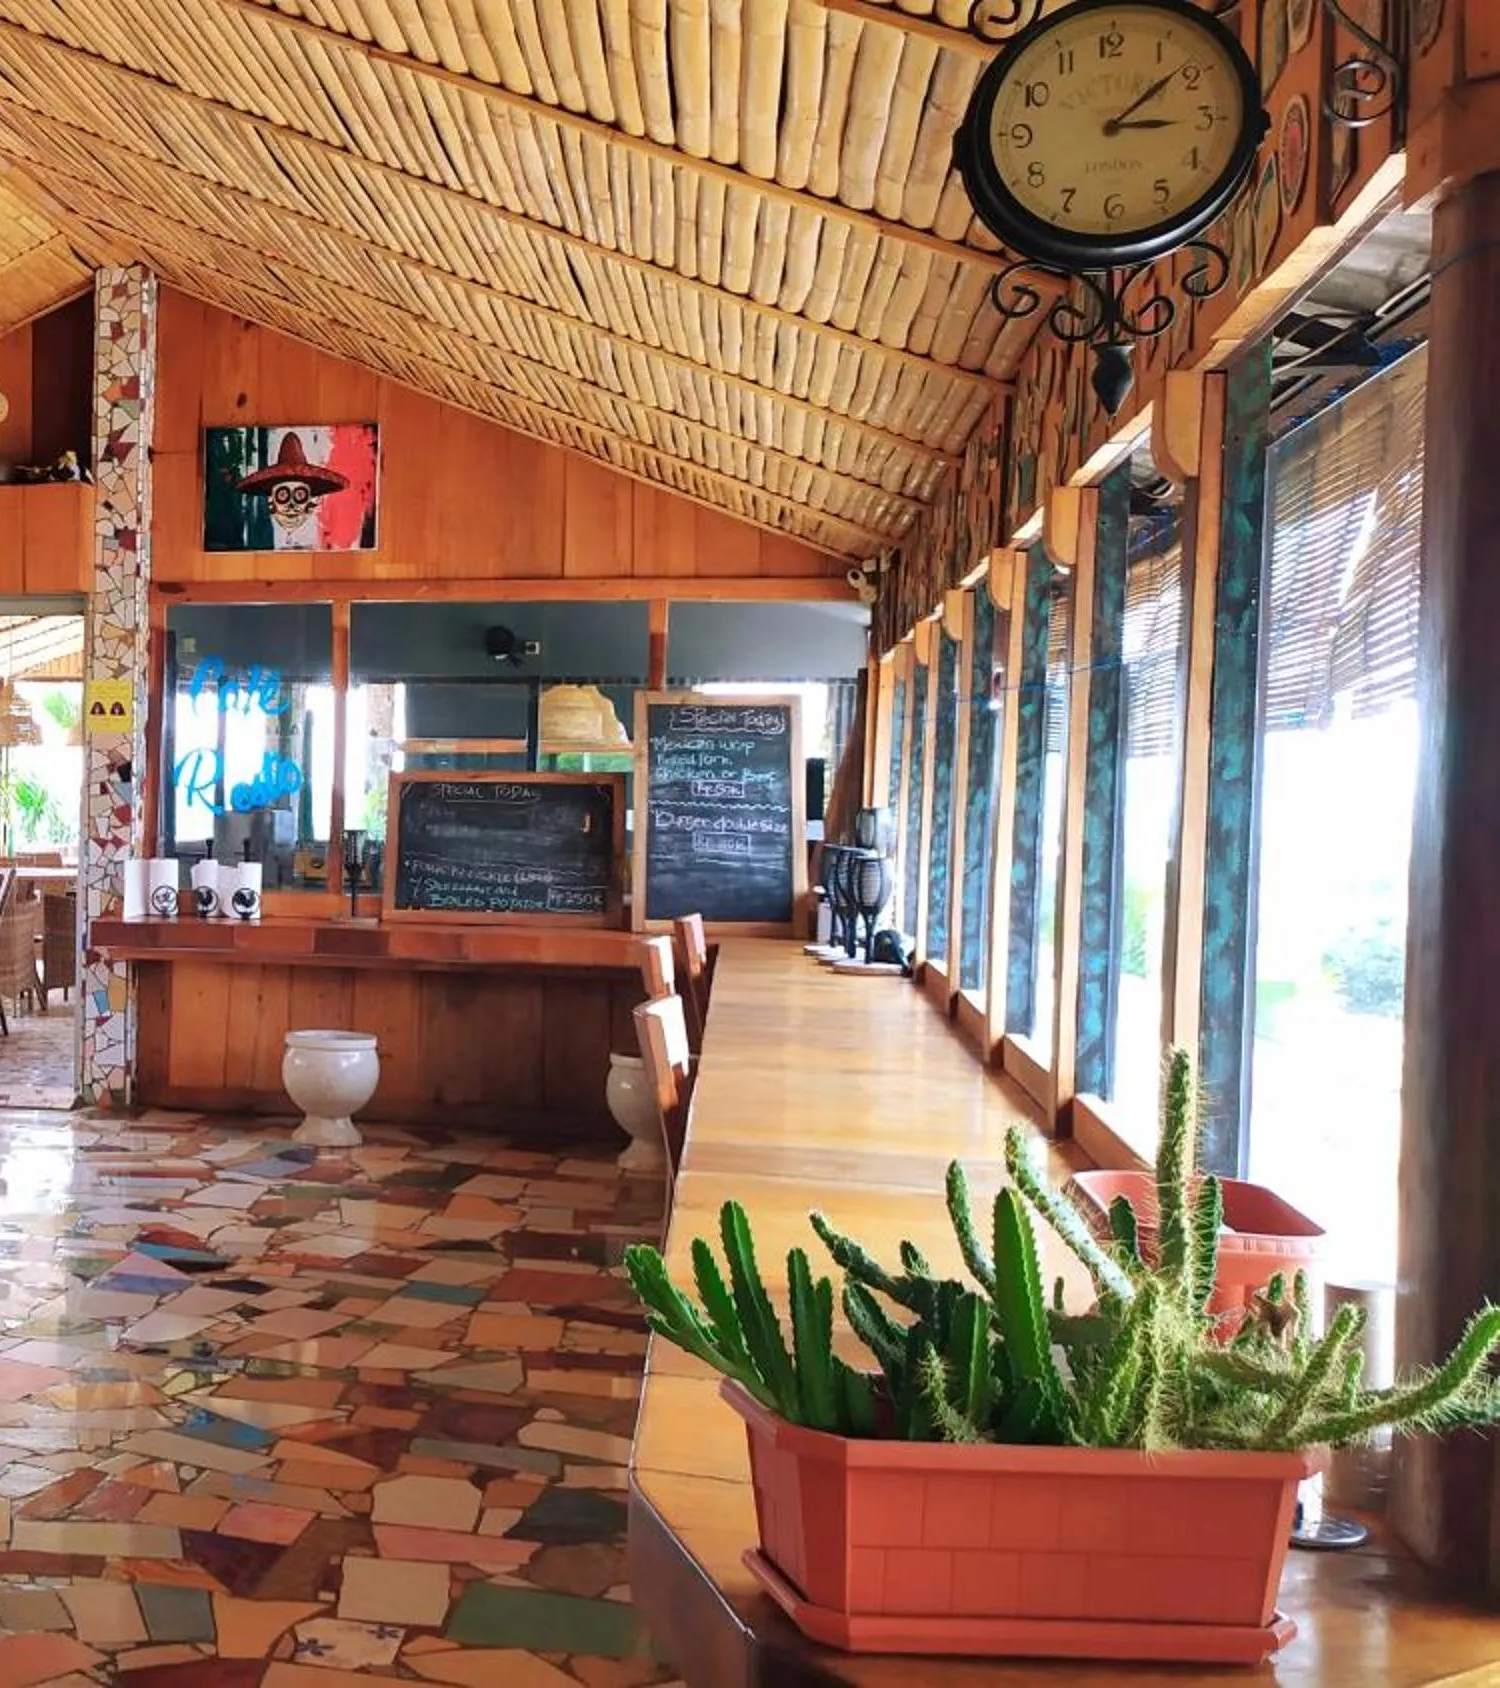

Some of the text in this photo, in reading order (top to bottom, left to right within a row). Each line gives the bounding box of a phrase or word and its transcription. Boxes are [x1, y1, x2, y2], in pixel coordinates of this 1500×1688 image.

[1099, 31, 1125, 59] 12
[1155, 40, 1163, 64] 1
[1057, 50, 1074, 75] 11
[1181, 65, 1200, 91] 2
[1024, 81, 1050, 107] 10
[1194, 105, 1214, 131] 3
[1011, 123, 1033, 149] 9
[1181, 145, 1199, 171] 4
[1027, 161, 1046, 188] 8
[1060, 188, 1077, 214] 7
[1153, 179, 1170, 205] 5
[1103, 193, 1125, 220] 6
